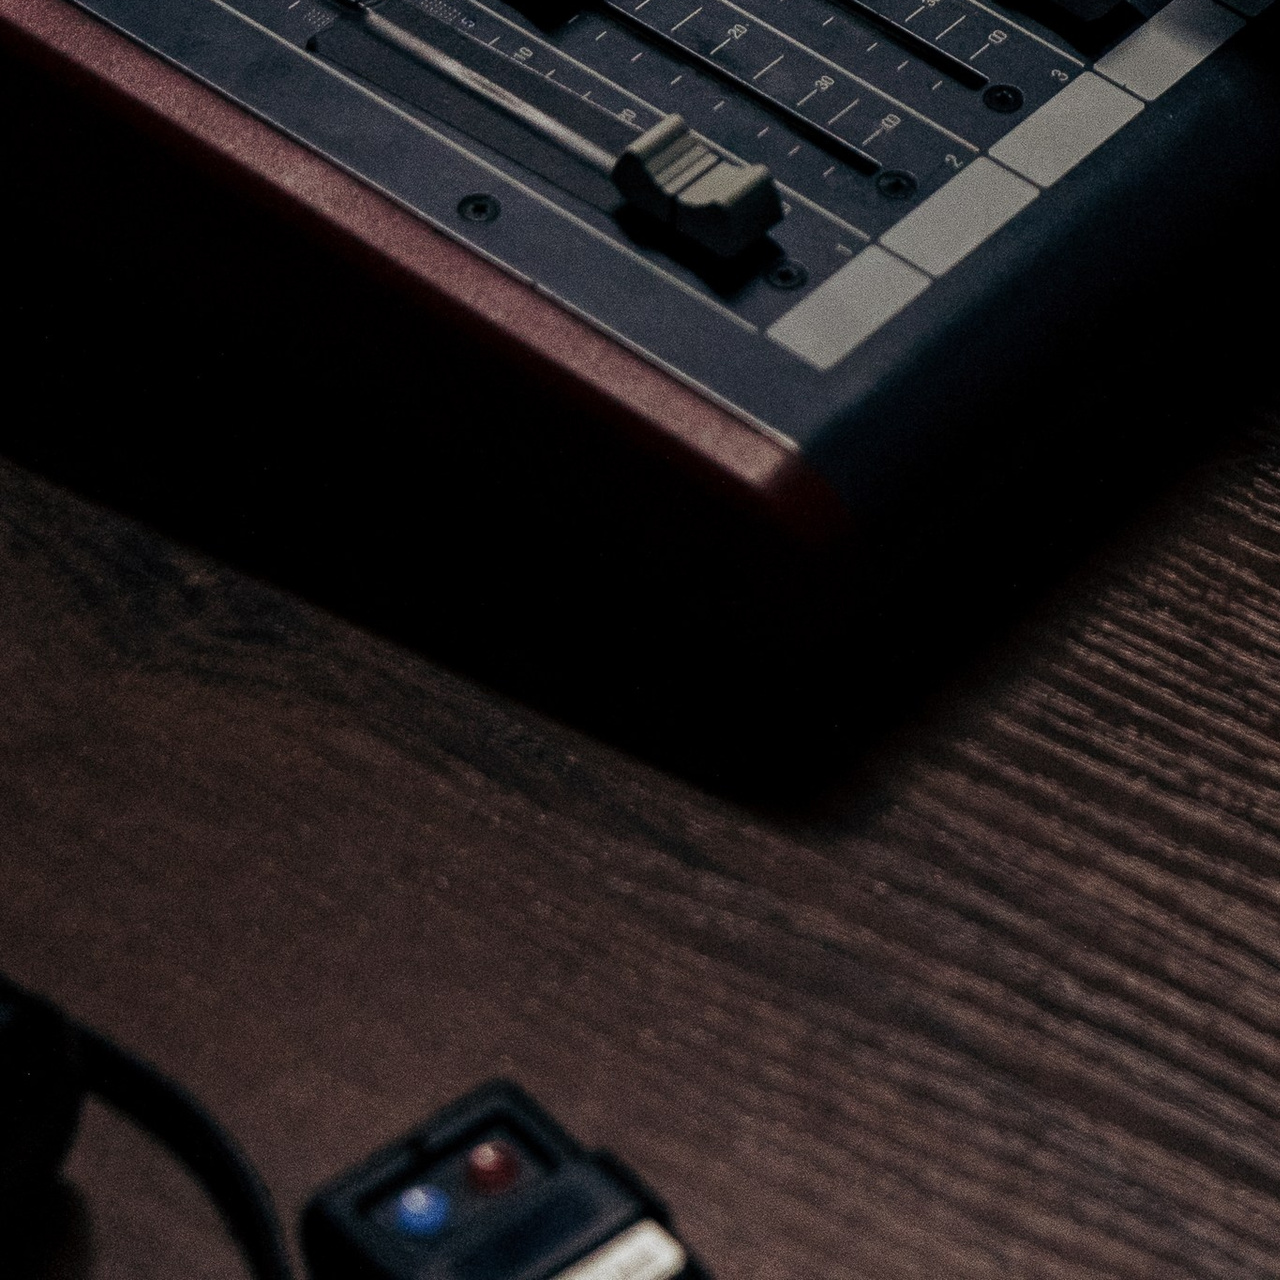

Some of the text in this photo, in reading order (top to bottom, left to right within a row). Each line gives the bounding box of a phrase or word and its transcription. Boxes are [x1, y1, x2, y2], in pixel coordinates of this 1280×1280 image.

[727, 23, 748, 40] 20
[513, 46, 534, 61] 10
[814, 74, 836, 91] 30
[1051, 68, 1069, 82] 3
[944, 154, 964, 169] 2
